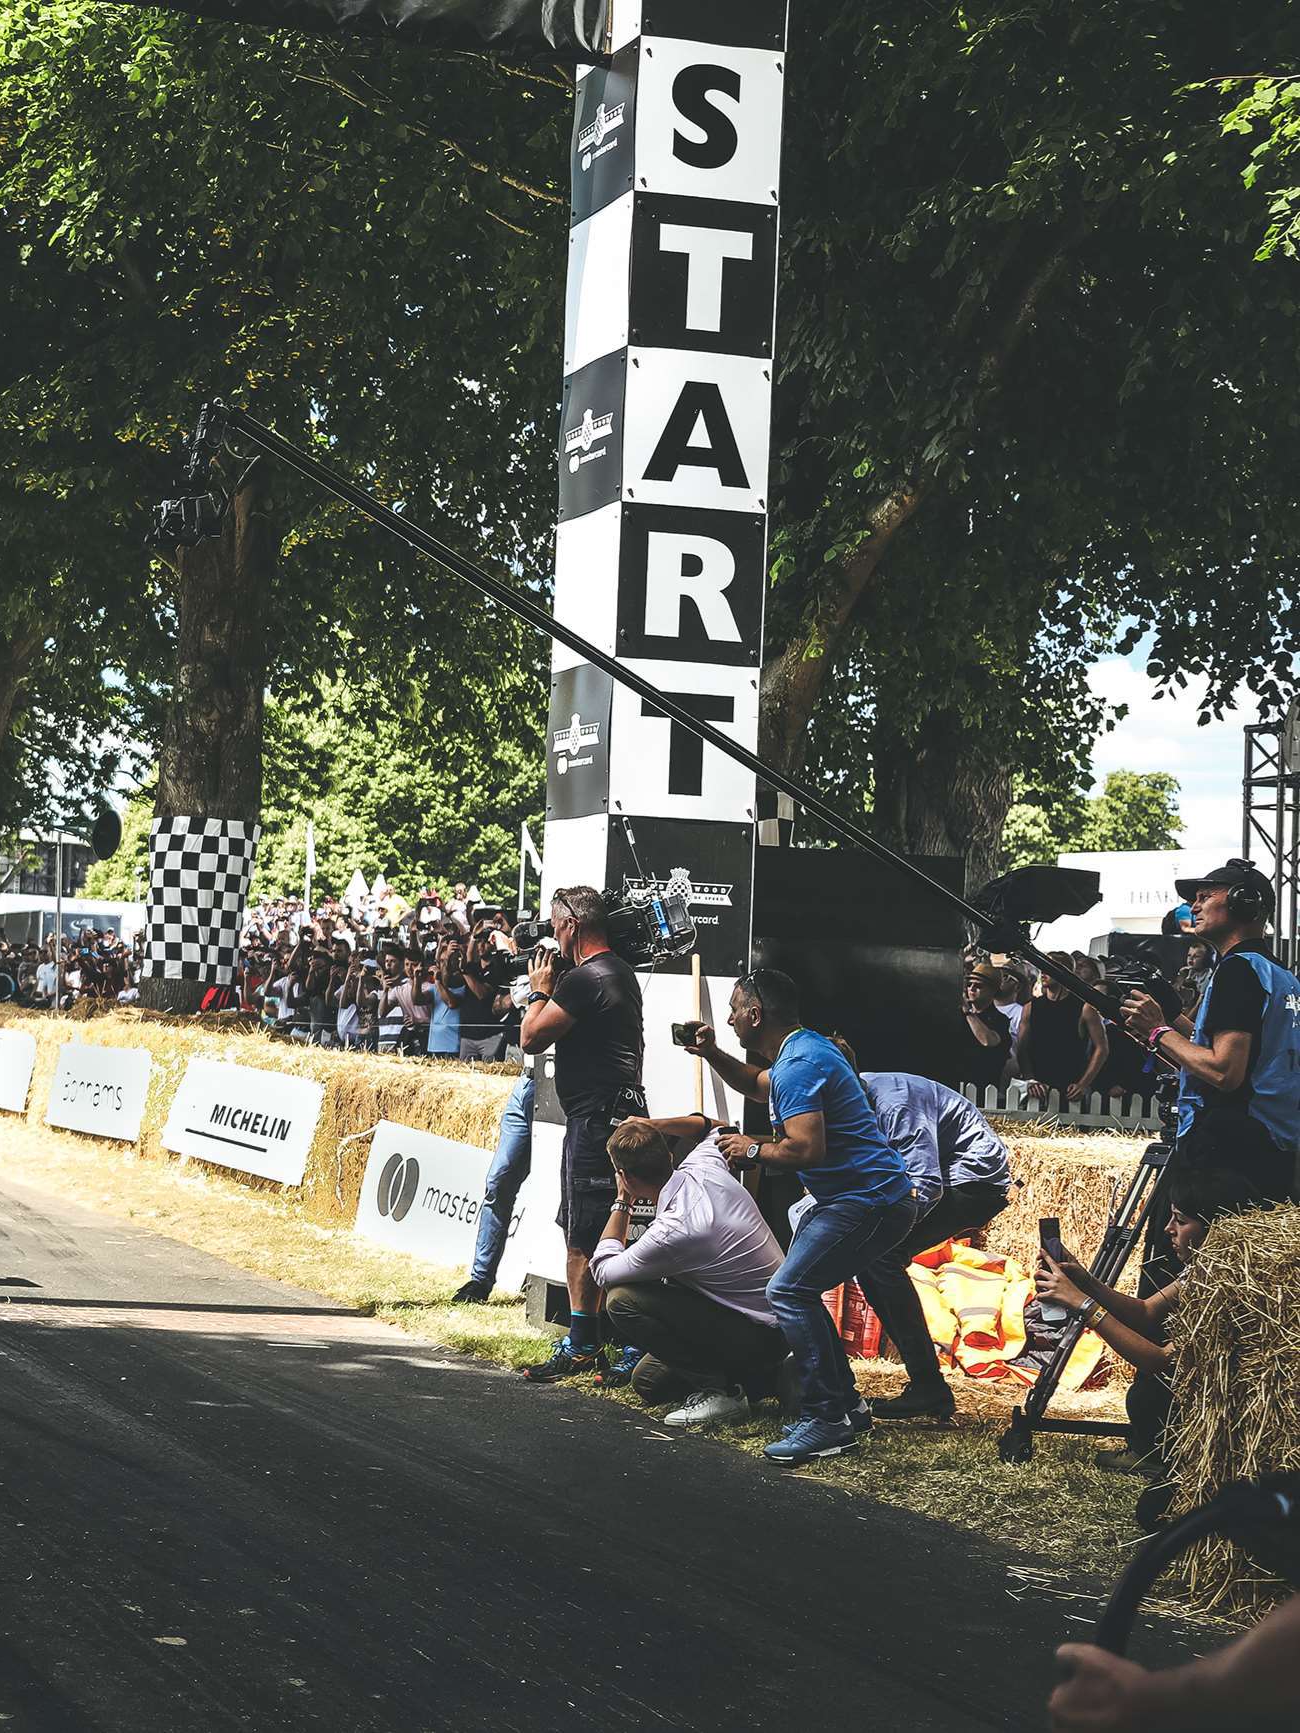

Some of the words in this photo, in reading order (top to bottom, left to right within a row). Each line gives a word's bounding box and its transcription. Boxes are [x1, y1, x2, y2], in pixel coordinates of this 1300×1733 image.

[641, 64, 753, 797] START
[209, 1104, 292, 1141] MICHELIN
[421, 1186, 526, 1239] masterd
